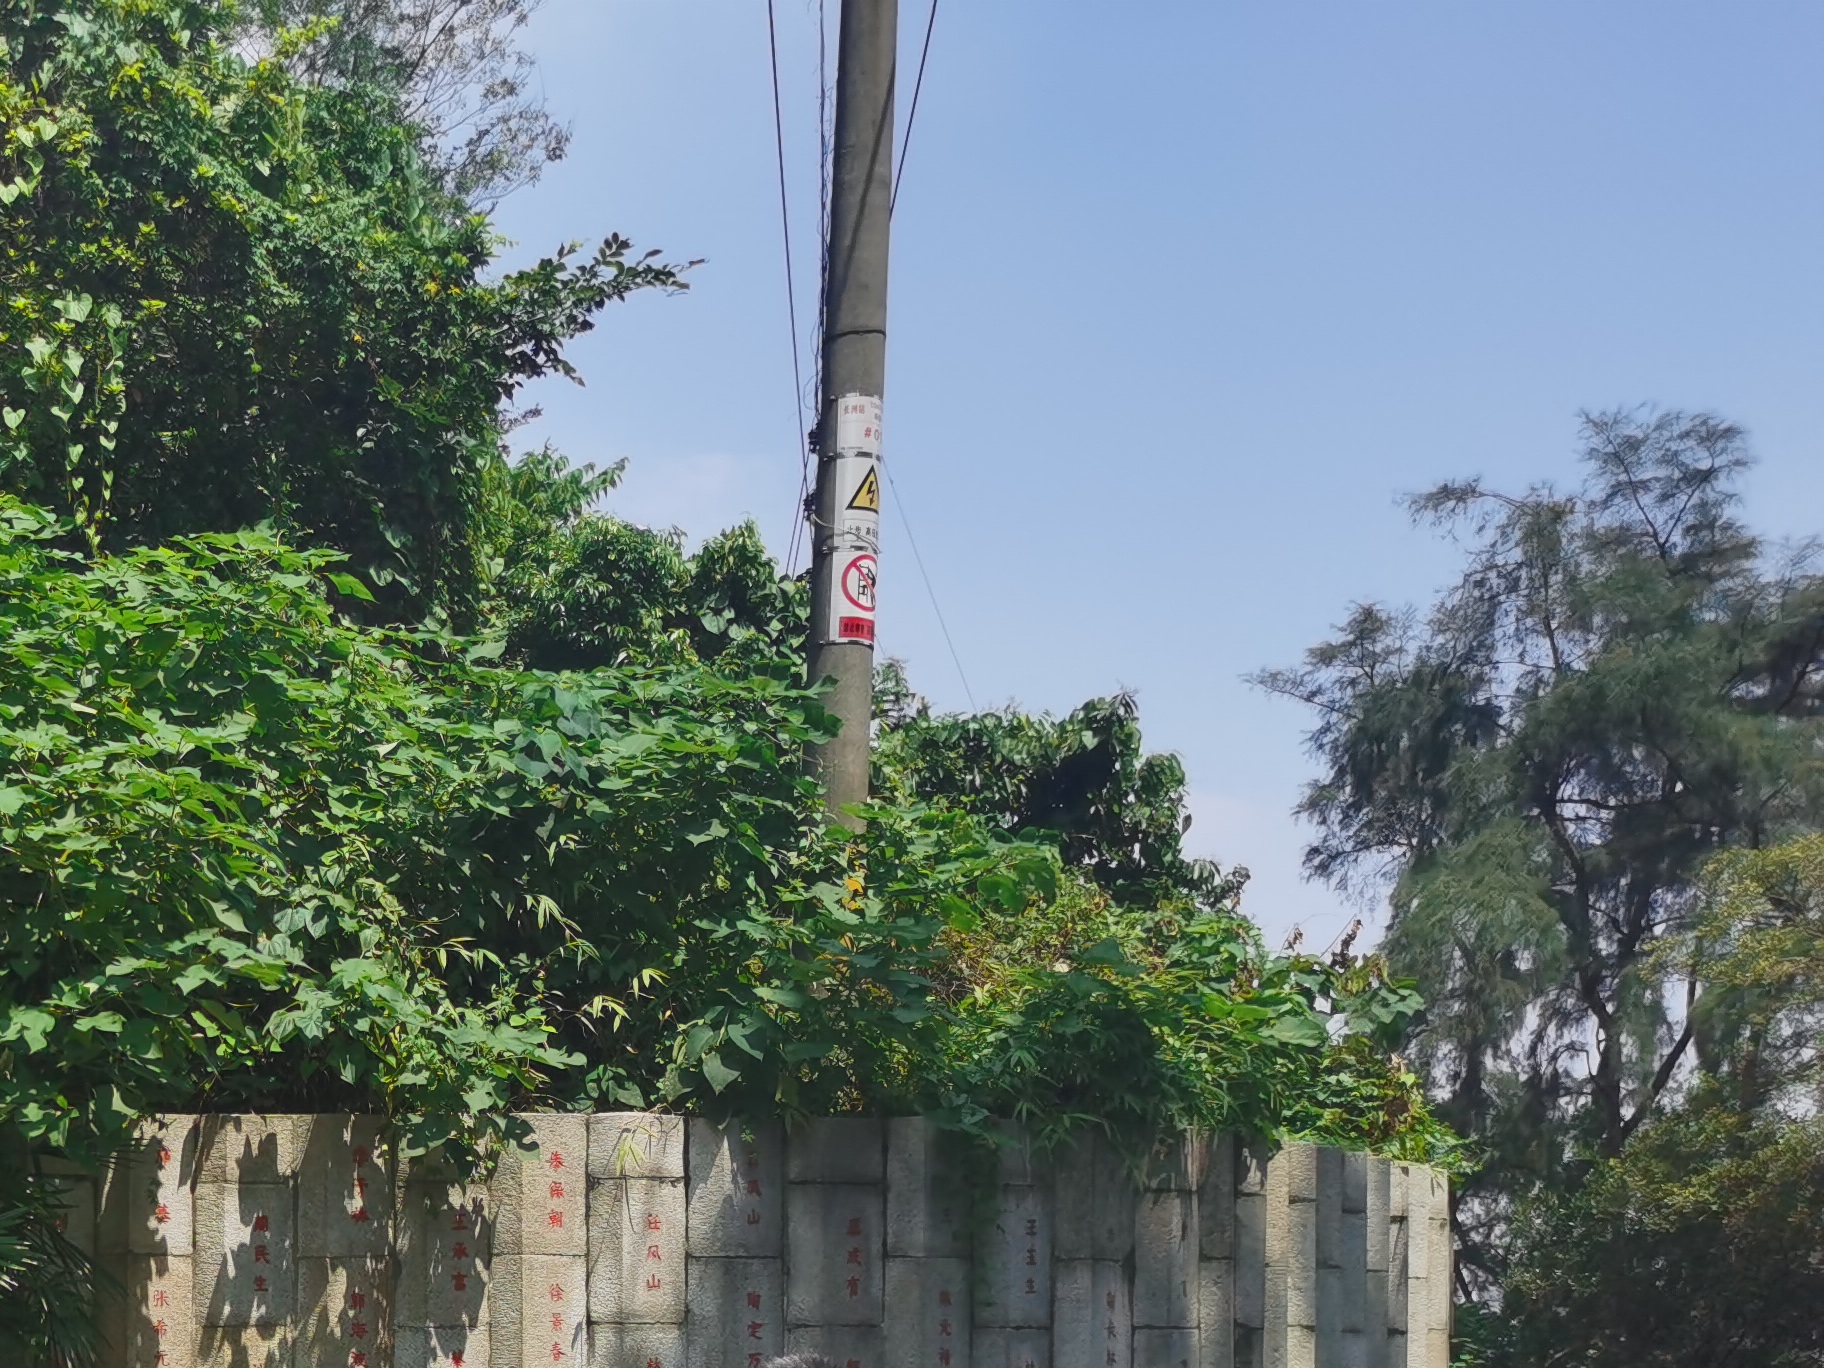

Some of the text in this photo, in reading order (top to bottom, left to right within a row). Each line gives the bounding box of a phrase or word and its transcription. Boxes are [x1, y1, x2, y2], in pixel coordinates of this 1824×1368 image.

[252, 1214, 270, 1293] 周民生
[152, 1289, 172, 1368] 张希元
[548, 1282, 566, 1362] 徐景春
